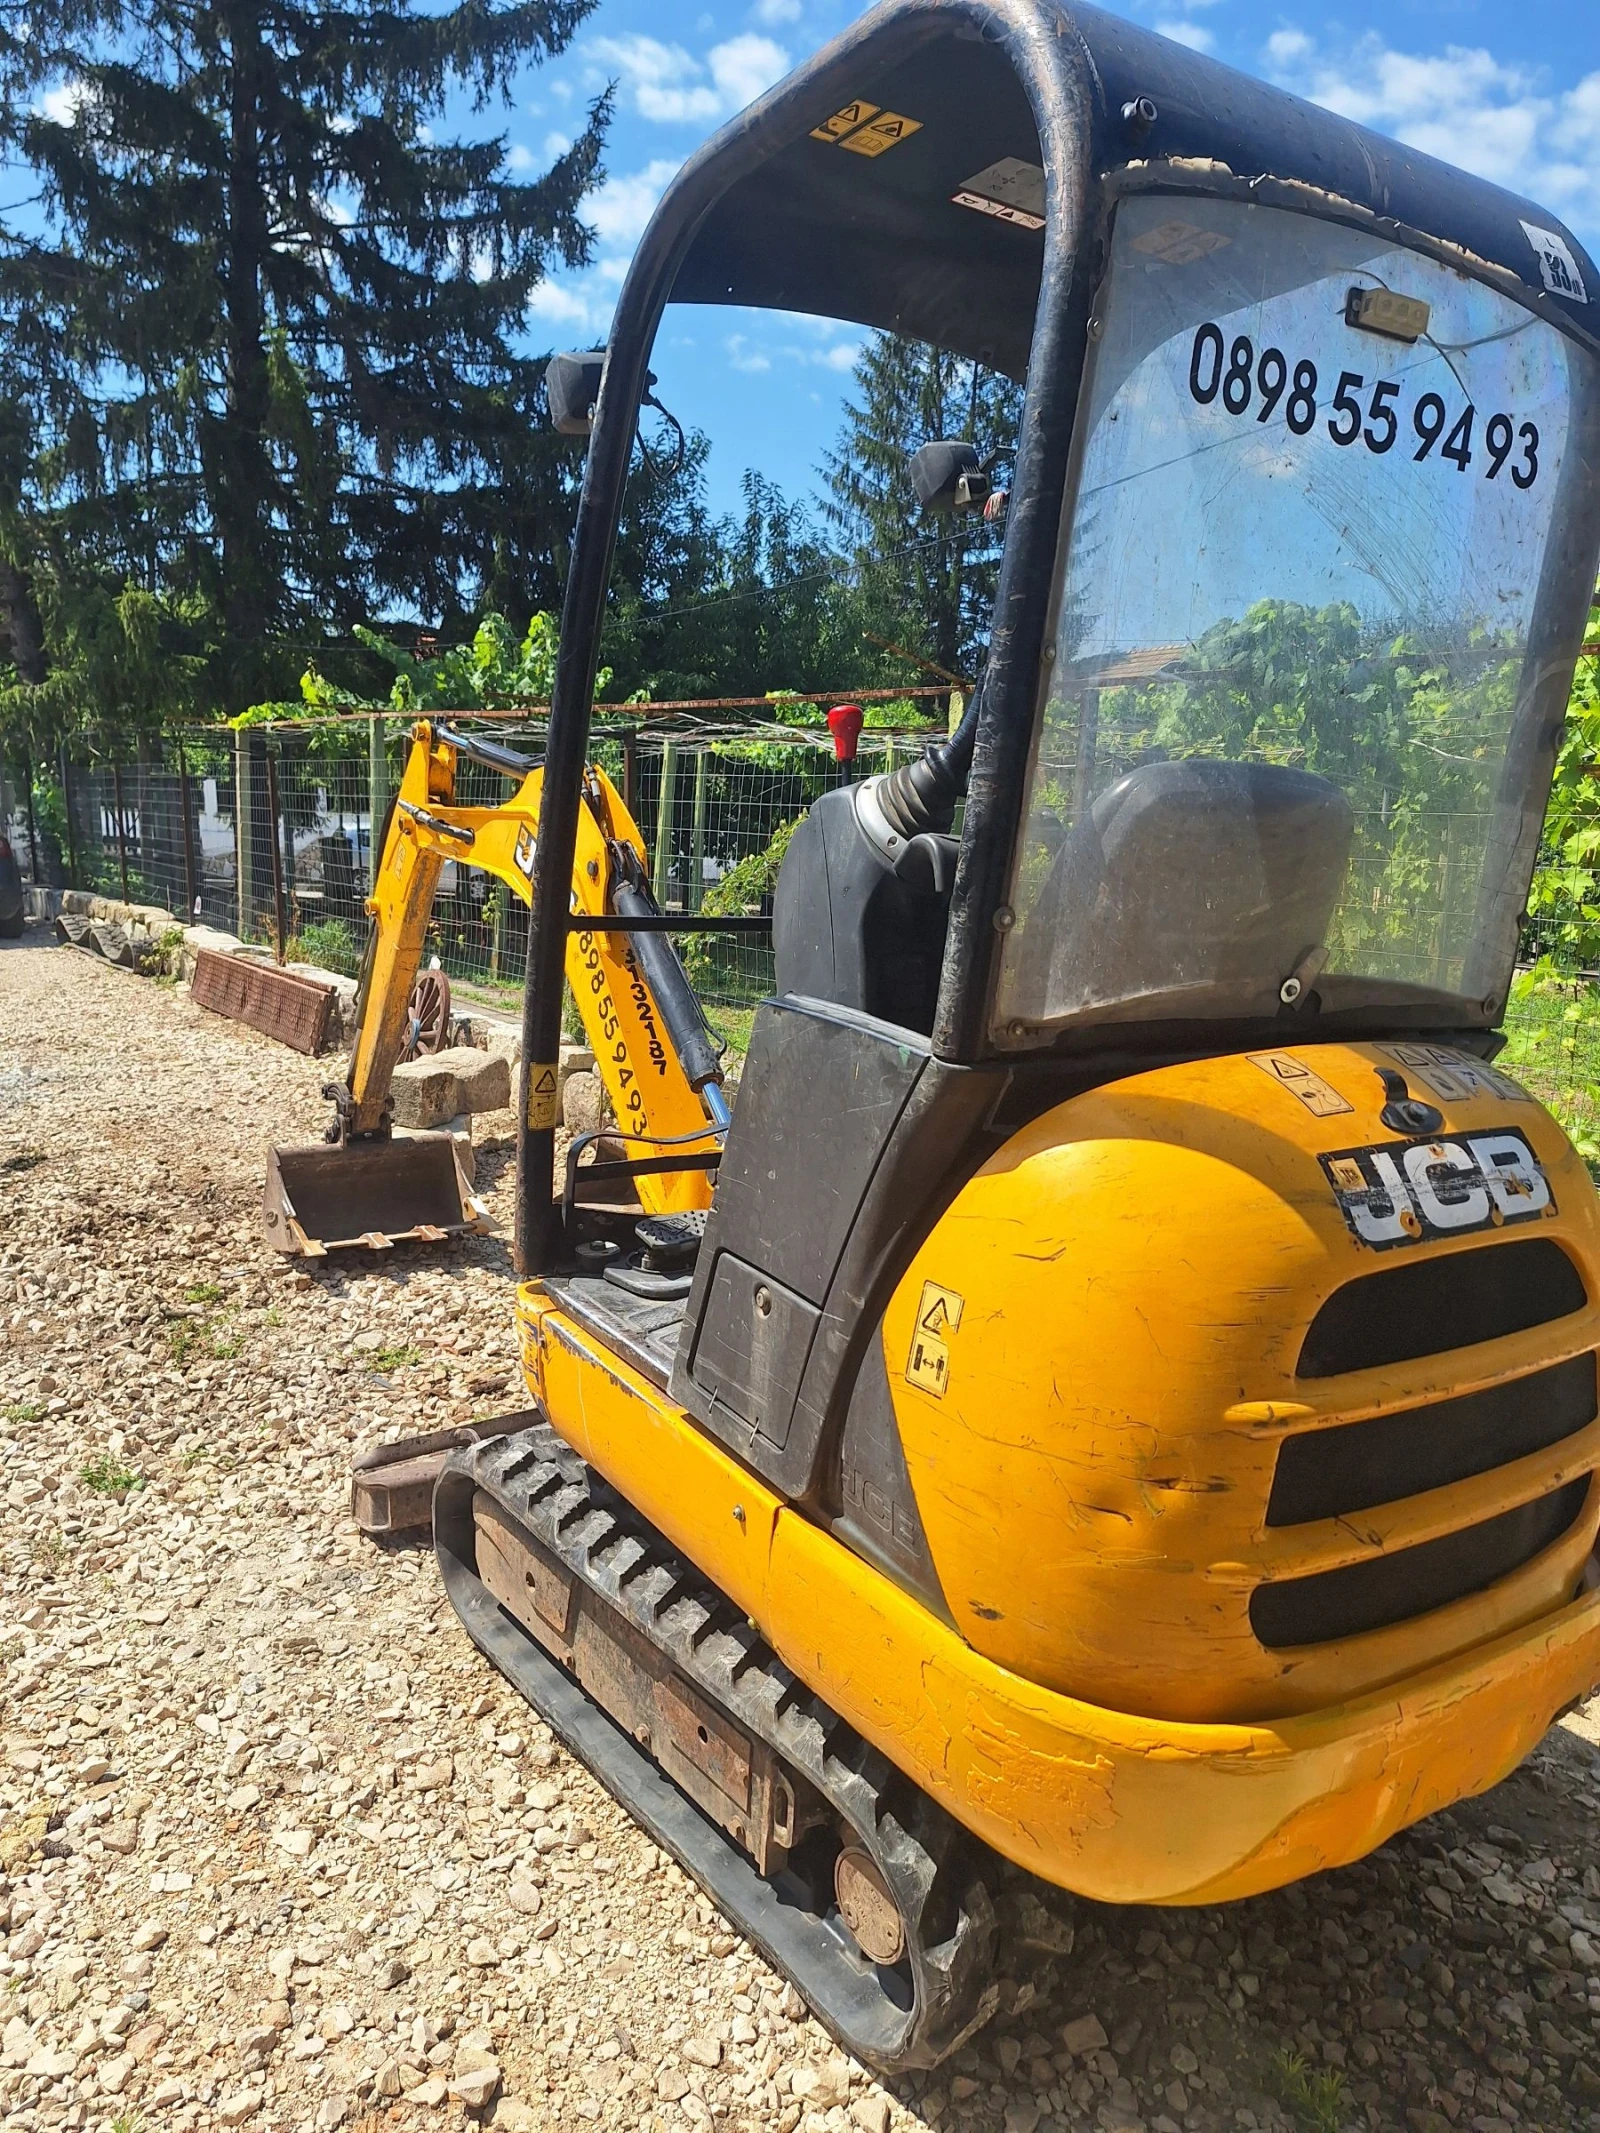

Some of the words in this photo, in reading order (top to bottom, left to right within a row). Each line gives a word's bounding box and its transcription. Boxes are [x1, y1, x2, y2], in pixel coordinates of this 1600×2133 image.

[1189, 322, 1318, 436] 0898
[1328, 370, 1401, 454] 55
[1412, 392, 1475, 473] 94
[1484, 413, 1540, 490] 93
[1349, 1135, 1550, 1242] JCB
